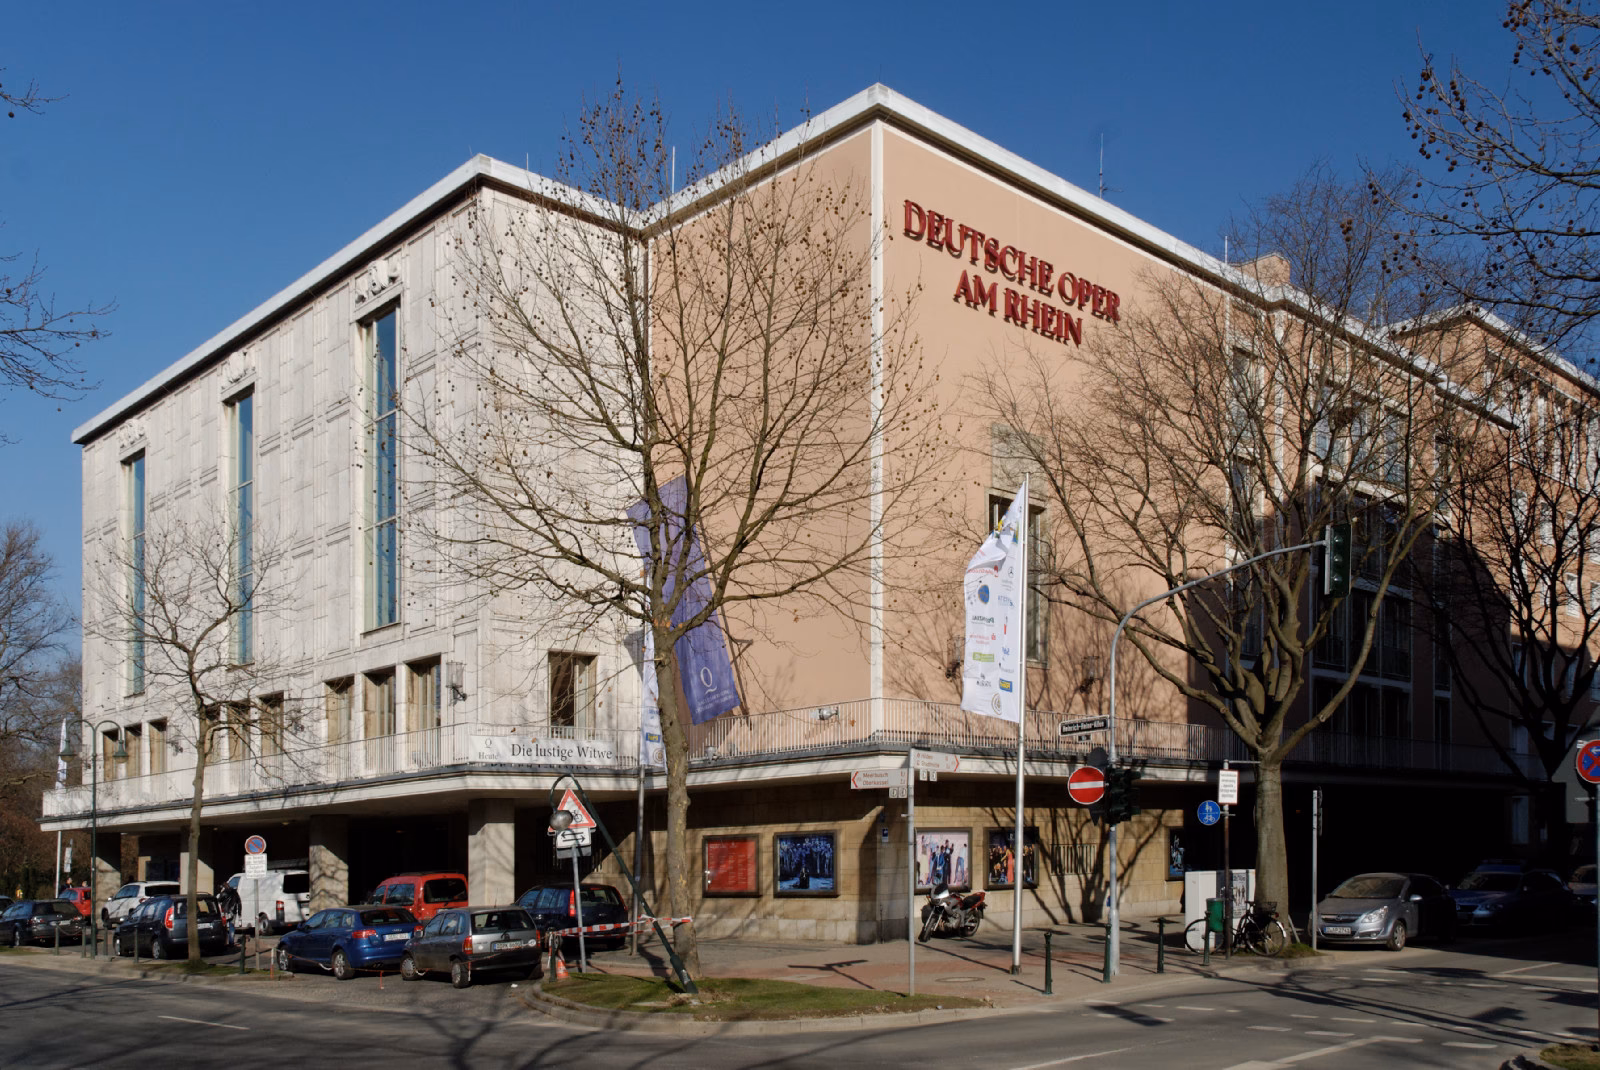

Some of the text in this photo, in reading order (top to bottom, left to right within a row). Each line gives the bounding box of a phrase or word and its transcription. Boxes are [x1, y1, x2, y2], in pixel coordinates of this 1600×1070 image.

[903, 199, 1121, 324] DEUTSCHE OPER
[953, 269, 1083, 346] AM RHEIN
[478, 751, 498, 760] Heute
[511, 743, 613, 761] Die lustige Witwe
